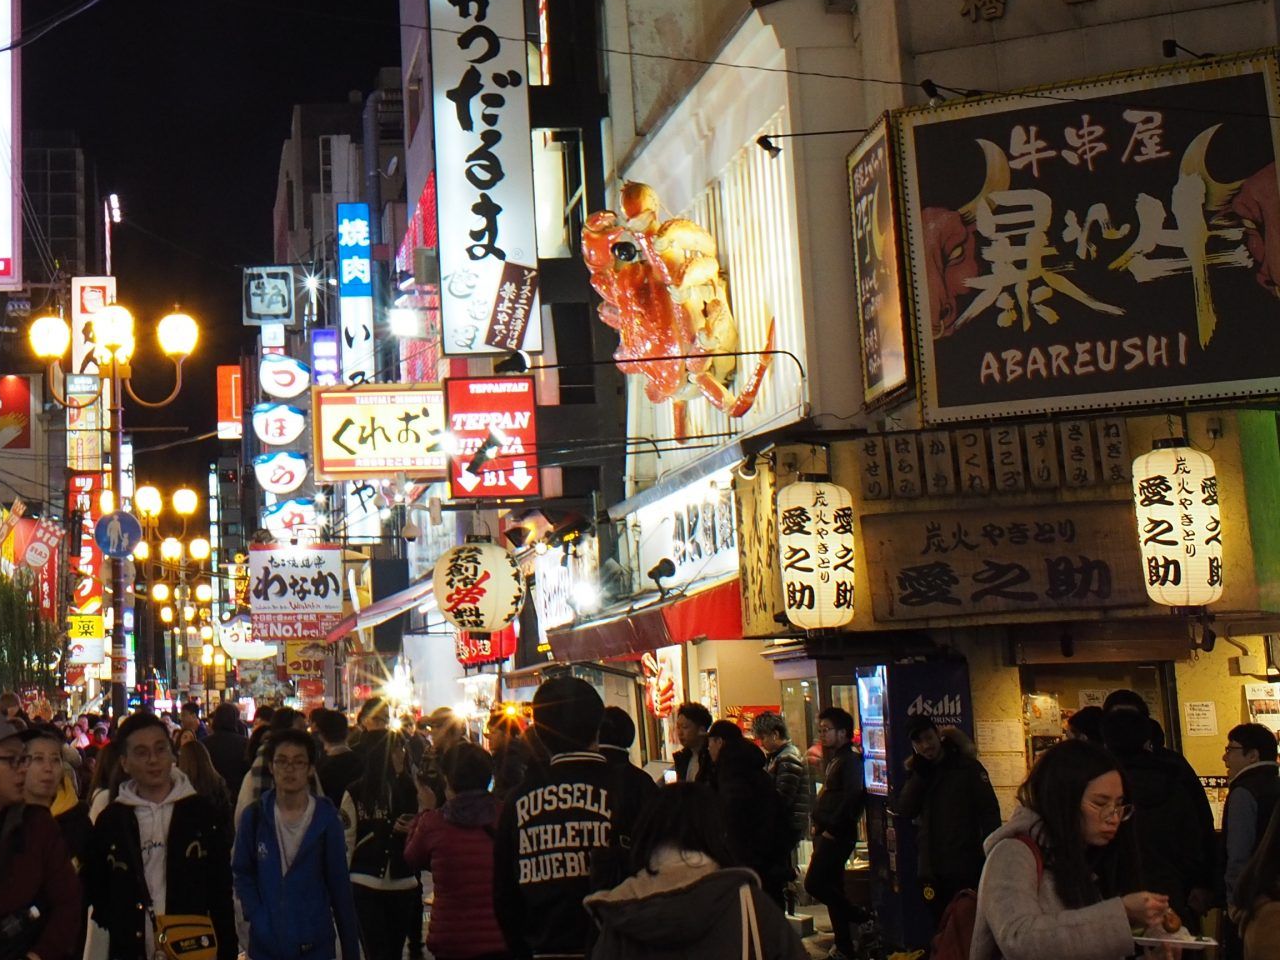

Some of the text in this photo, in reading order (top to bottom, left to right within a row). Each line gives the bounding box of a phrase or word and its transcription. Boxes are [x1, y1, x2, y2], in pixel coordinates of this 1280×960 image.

[1008, 108, 1171, 178] 牛串屋
[338, 217, 371, 285] 焼肉
[954, 170, 1255, 352] 暴れ牛
[979, 332, 1190, 386] ABAREUSHI
[452, 410, 532, 431] TEPPAN
[482, 469, 507, 487] B1
[861, 439, 883, 497] せせり
[894, 438, 917, 494] はらみ
[928, 440, 949, 489] かわ
[962, 434, 984, 490] つくね
[1067, 423, 1089, 481] ささみ
[1103, 423, 1126, 482] ねぎま
[1137, 473, 1183, 588] 愛之助
[1173, 455, 1197, 559] 炭火やきとり
[780, 505, 816, 611] 愛之助
[812, 489, 831, 584] 炭火やきとり
[921, 518, 1077, 555] 炭火やきとり
[252, 566, 341, 602] わなか
[898, 555, 1112, 606] 愛之助
[906, 693, 962, 717] Asahi
[516, 782, 612, 827] RUSSELL
[518, 819, 612, 856] ATHLETIC
